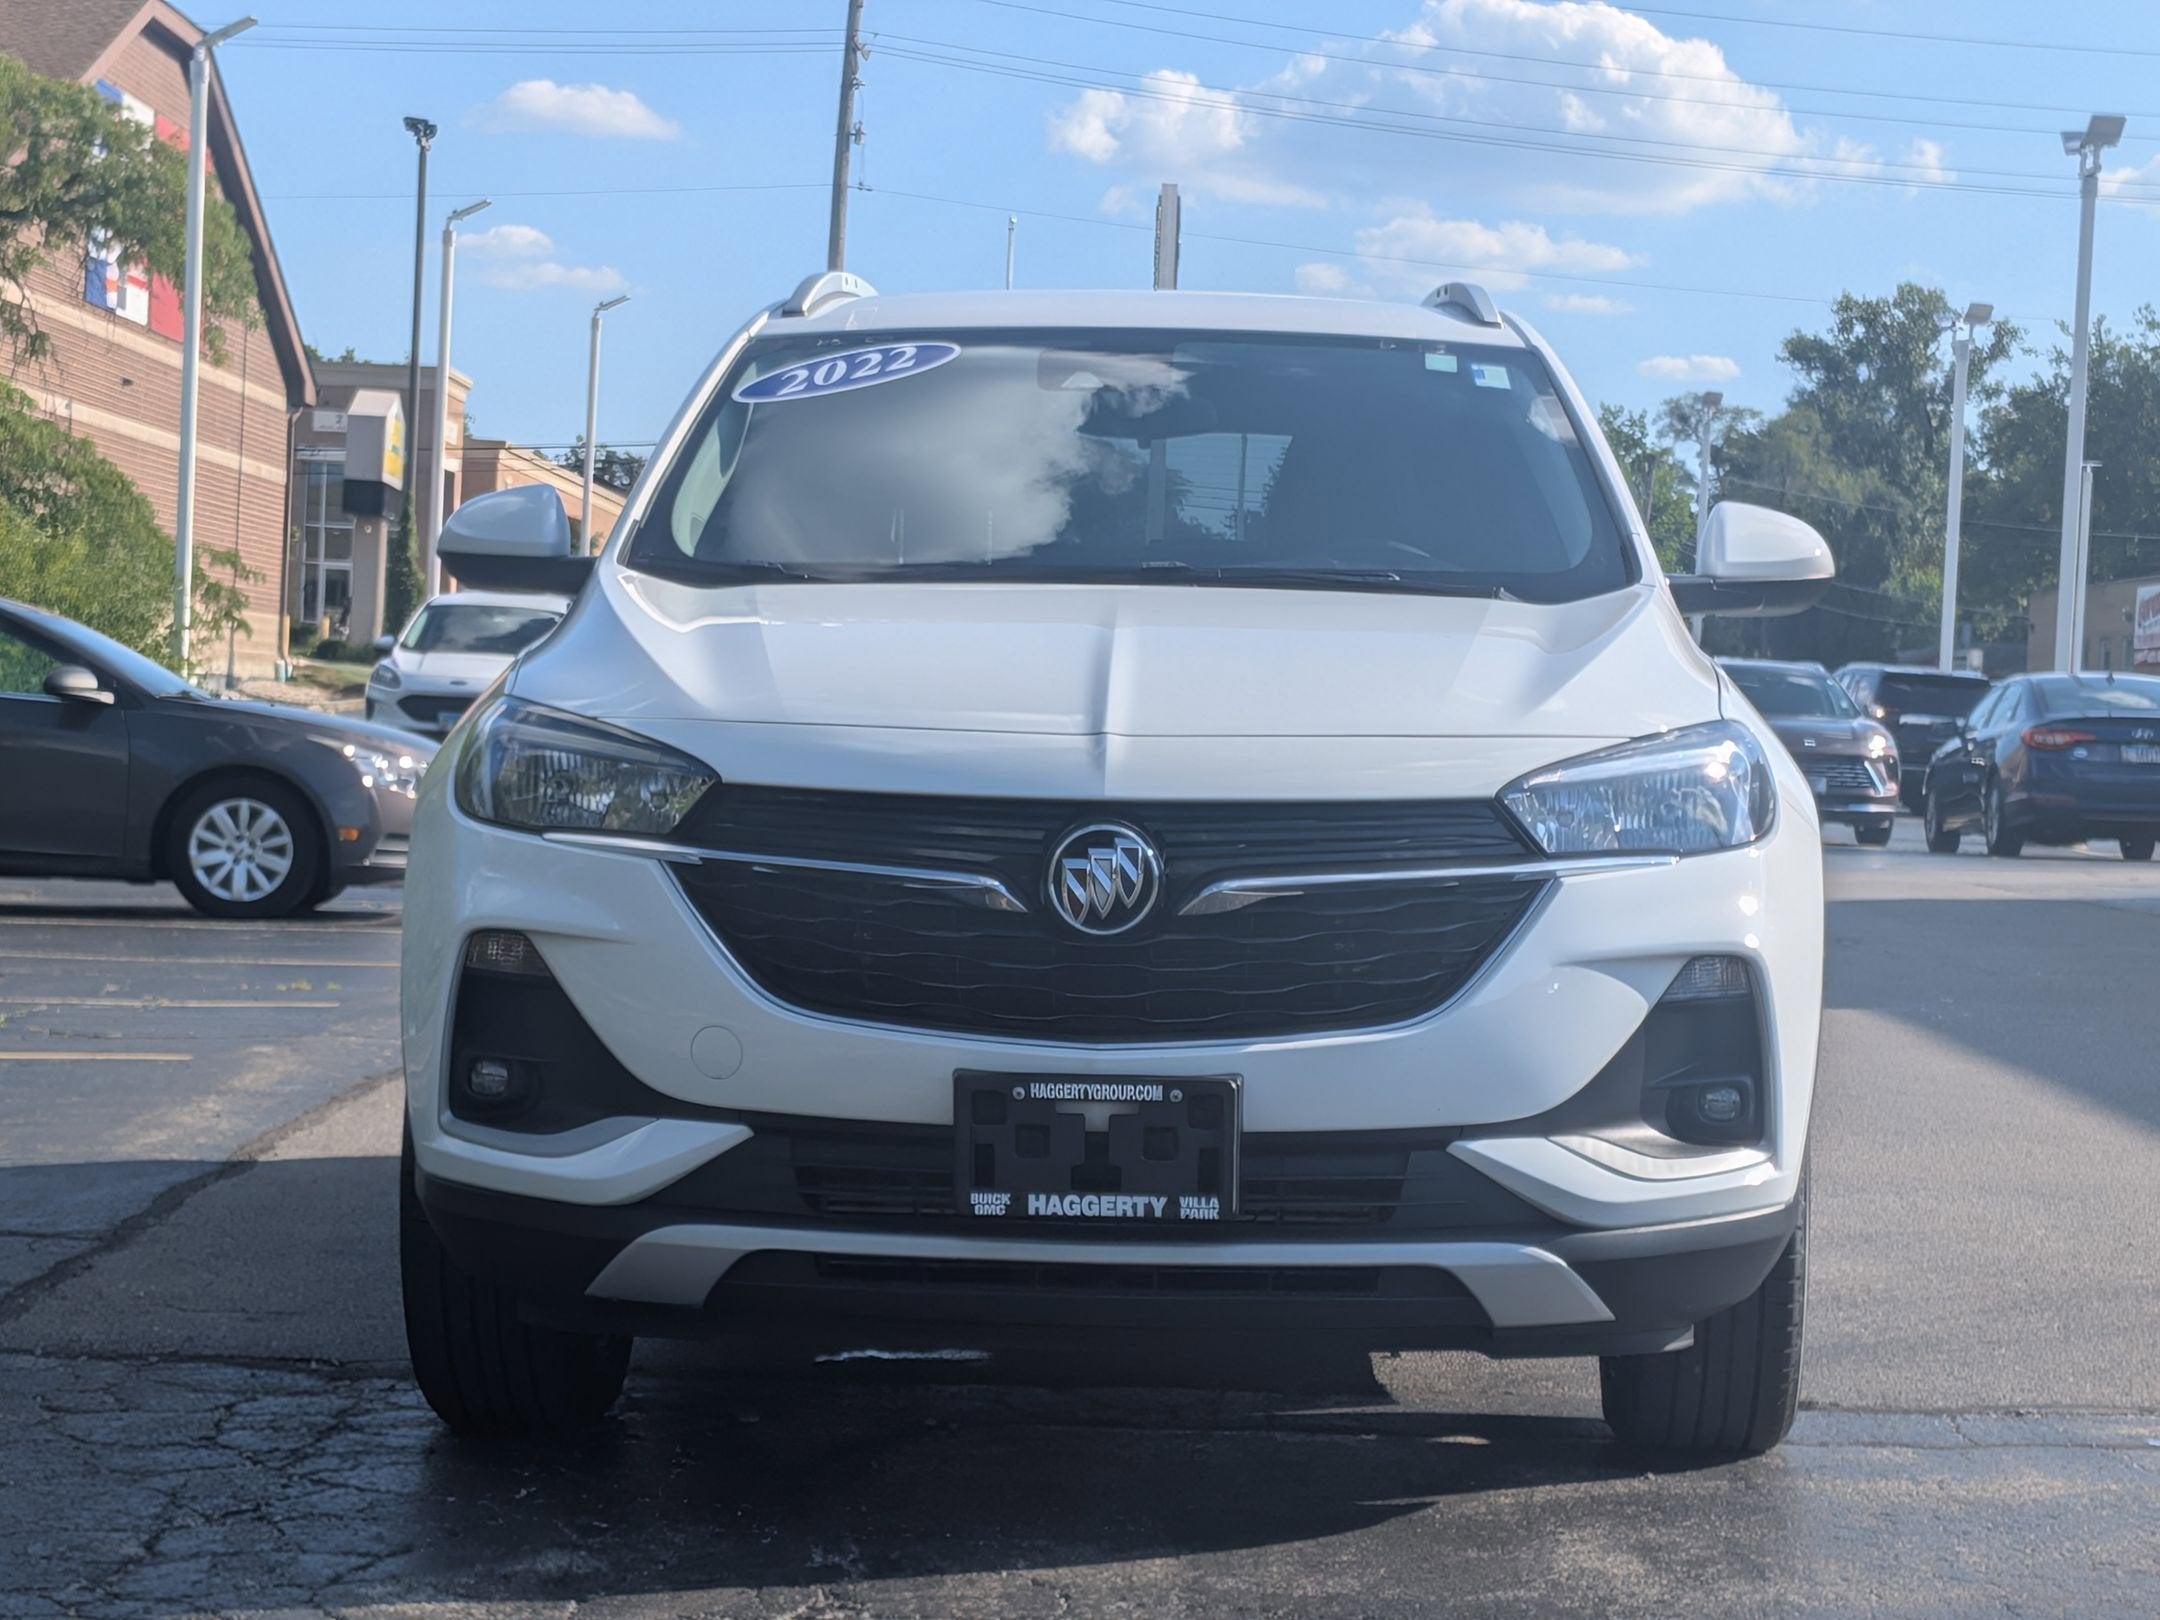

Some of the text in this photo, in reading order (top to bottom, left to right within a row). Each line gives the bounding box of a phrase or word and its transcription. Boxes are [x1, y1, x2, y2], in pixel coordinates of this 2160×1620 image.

[776, 346, 917, 396] 2022
[1030, 1083, 1163, 1101] HAGGERTYGROUP.COM
[970, 1193, 1011, 1205] BUICK
[1179, 1196, 1219, 1208] VILLA
[974, 1205, 1006, 1216] GMC
[1028, 1194, 1168, 1217] HAGGERTY
[1180, 1208, 1219, 1220] PARK
